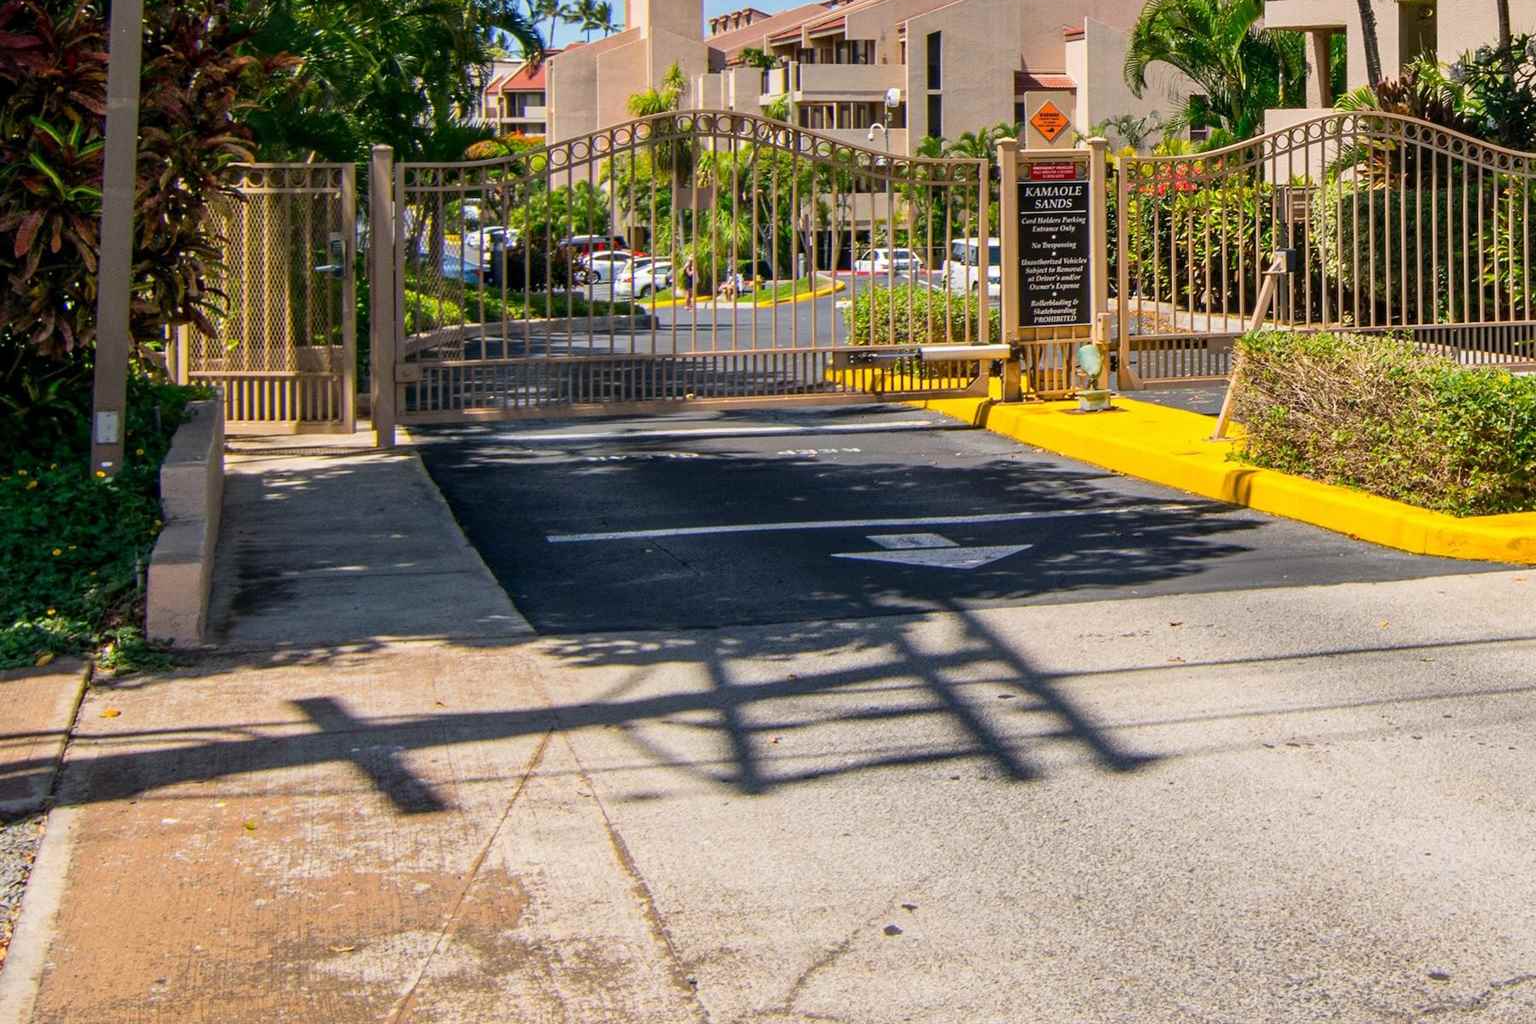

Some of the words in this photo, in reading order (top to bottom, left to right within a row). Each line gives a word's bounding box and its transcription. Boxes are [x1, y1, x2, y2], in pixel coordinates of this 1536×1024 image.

[1025, 186, 1082, 197] KAMAOLE
[1034, 198, 1073, 209] SANDS
[1021, 217, 1037, 225] Card
[1037, 216, 1061, 224] Holders
[1059, 225, 1076, 233] Only
[1021, 258, 1062, 266] Unauthorized
[1064, 257, 1087, 265] Vehicles
[1025, 267, 1048, 275] Subject
[1031, 299, 1072, 307] Rollerblading
[1034, 315, 1076, 323] PROHIBITED
